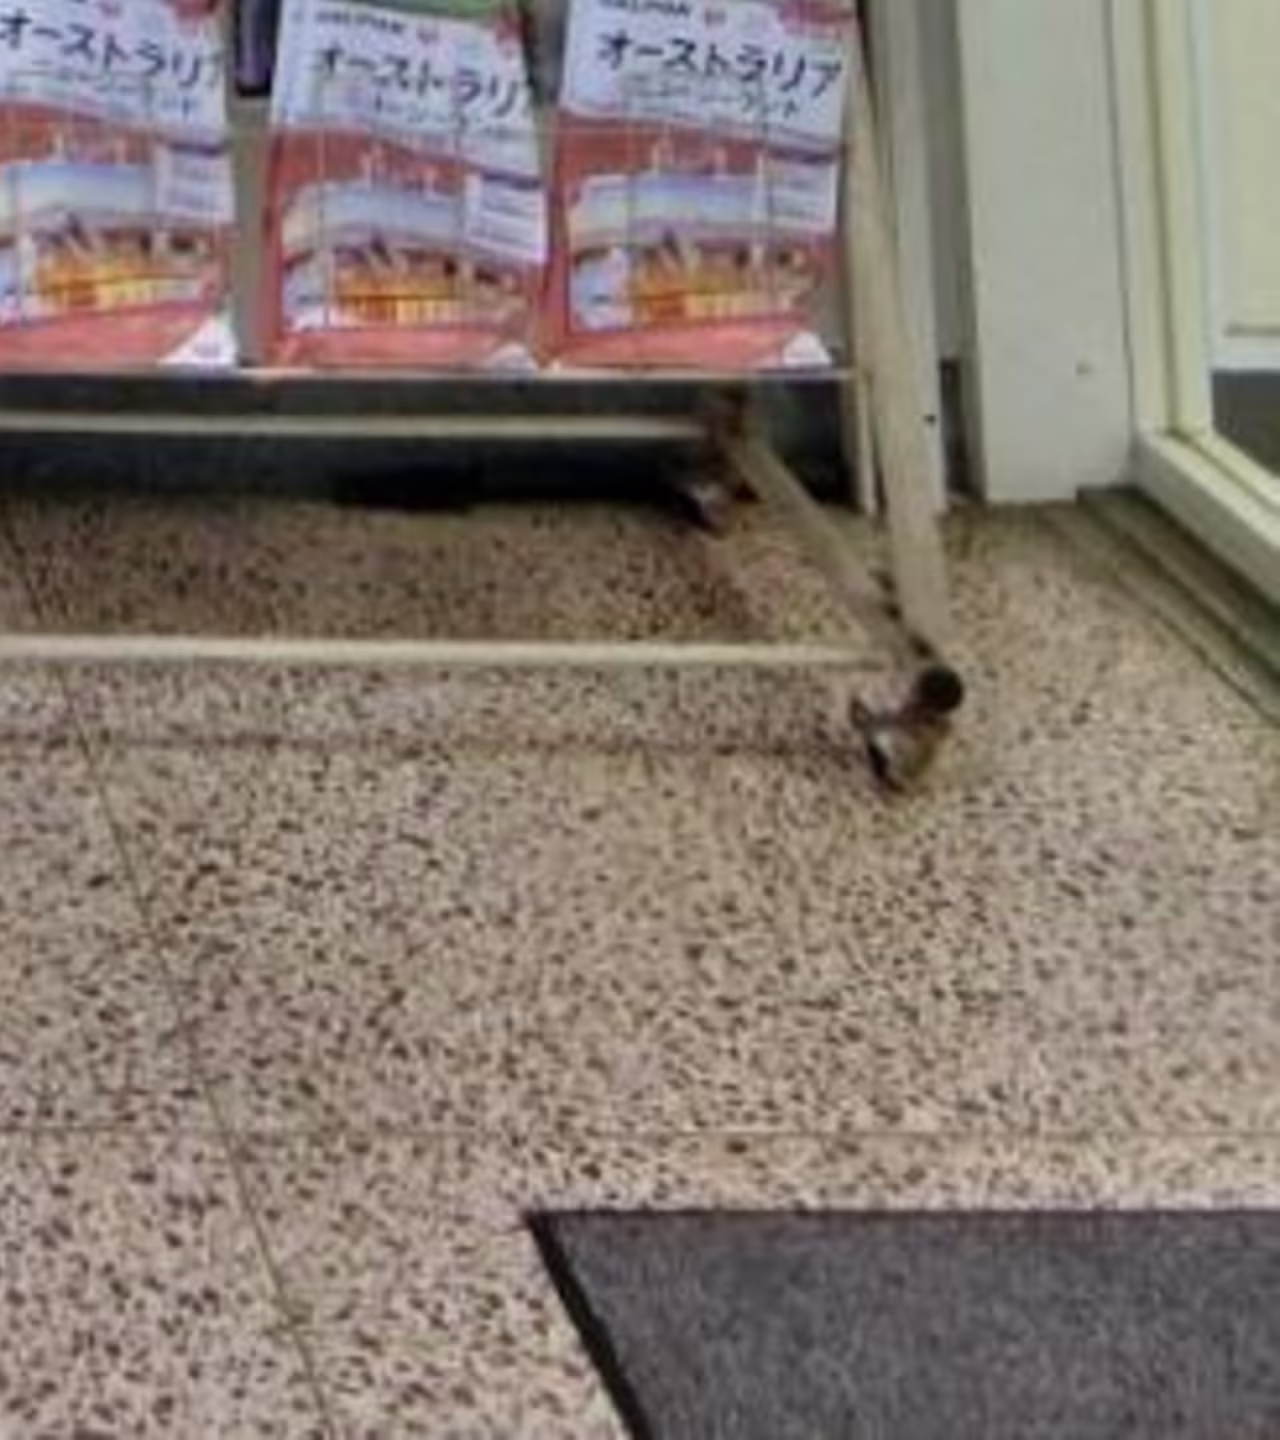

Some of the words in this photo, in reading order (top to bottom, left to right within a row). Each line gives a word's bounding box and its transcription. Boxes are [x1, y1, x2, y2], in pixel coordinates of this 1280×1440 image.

[314, 45, 525, 117] オーストラリ
[595, 27, 843, 100] オーストラリア
